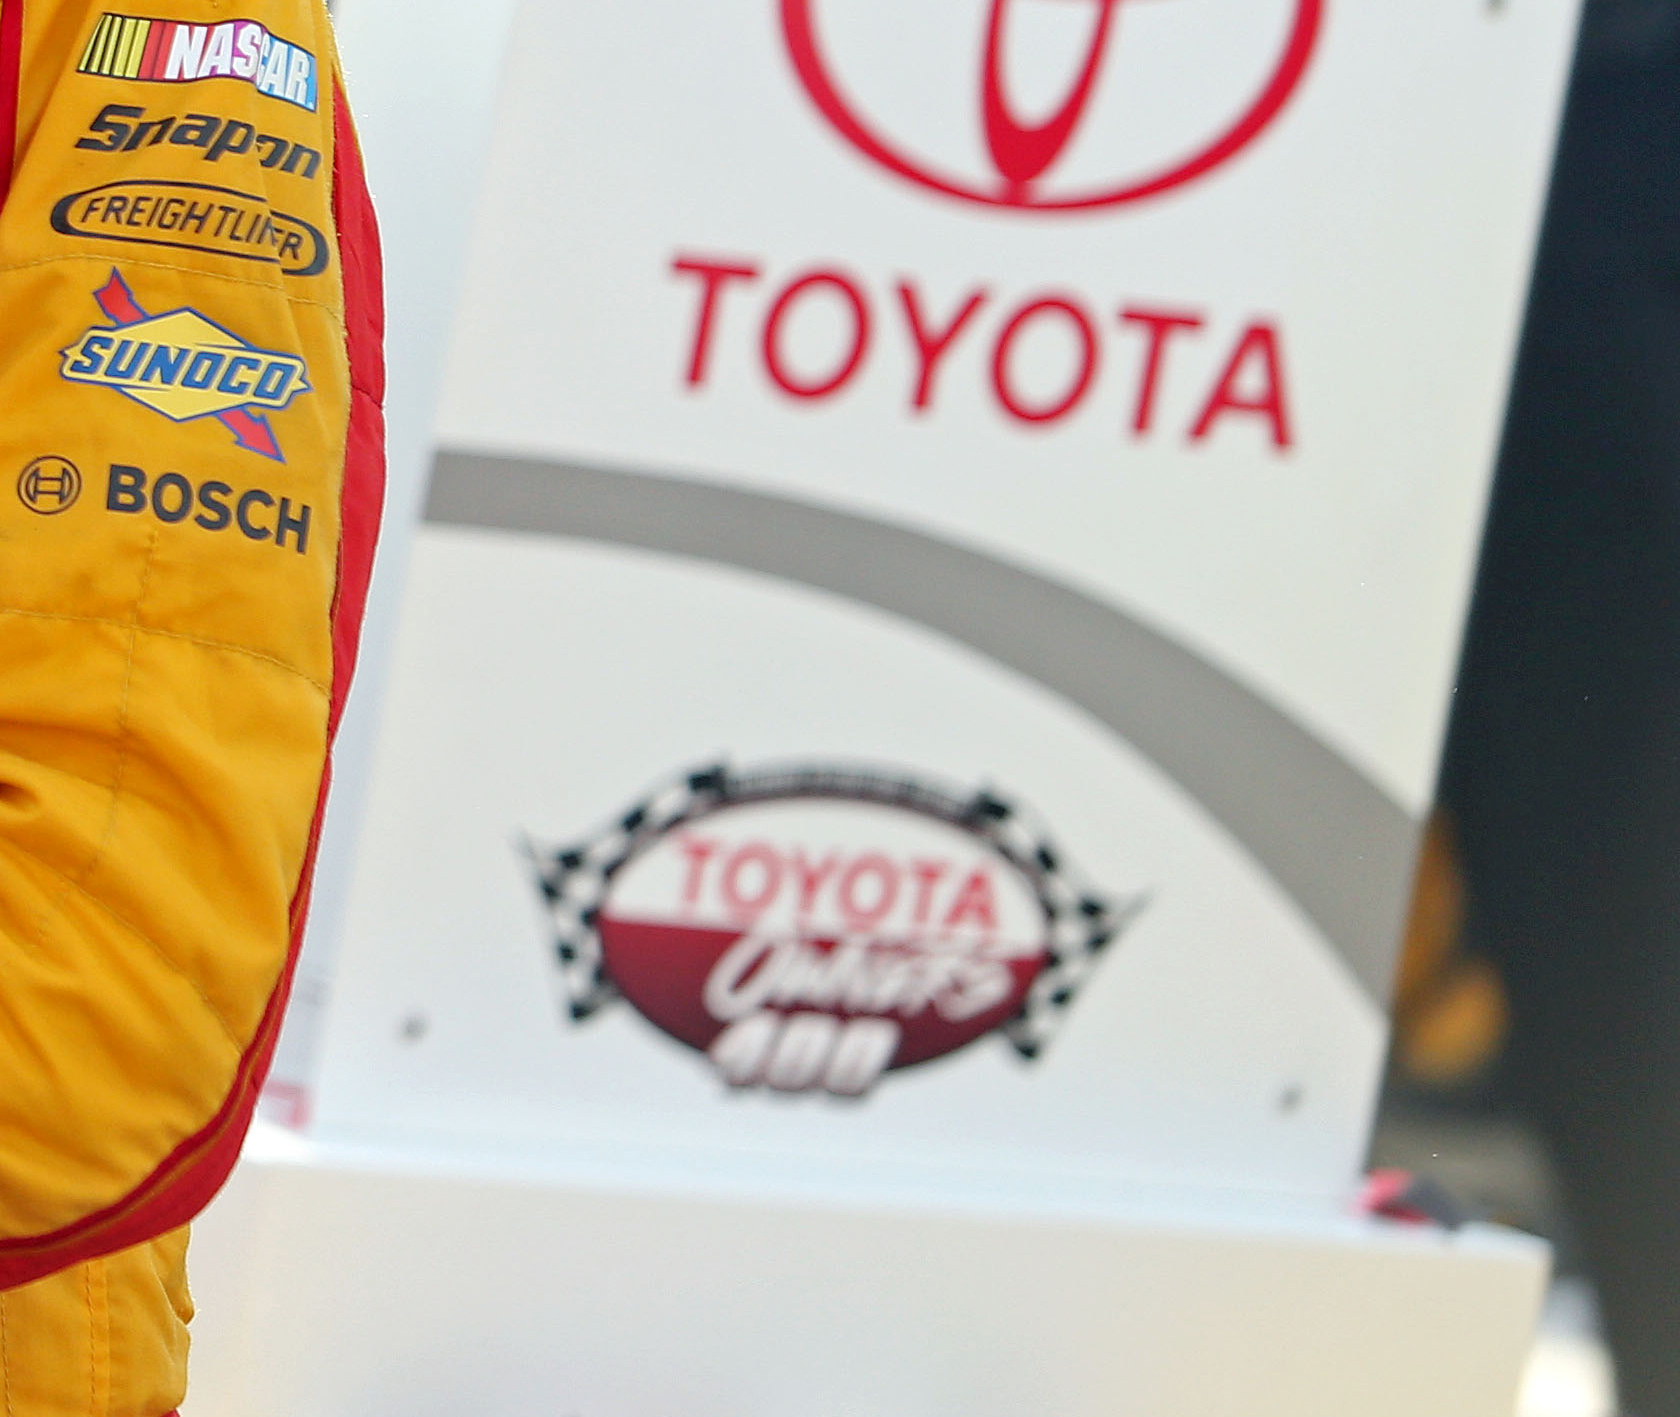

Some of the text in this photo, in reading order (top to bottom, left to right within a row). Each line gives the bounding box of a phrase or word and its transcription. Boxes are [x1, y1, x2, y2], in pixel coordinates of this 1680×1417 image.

[163, 22, 310, 108] NASCAR
[68, 334, 300, 400] SUNOCO
[670, 252, 1295, 455] TOYOTA
[106, 463, 311, 554] BOSCH
[678, 835, 1000, 933] TOYOTA
